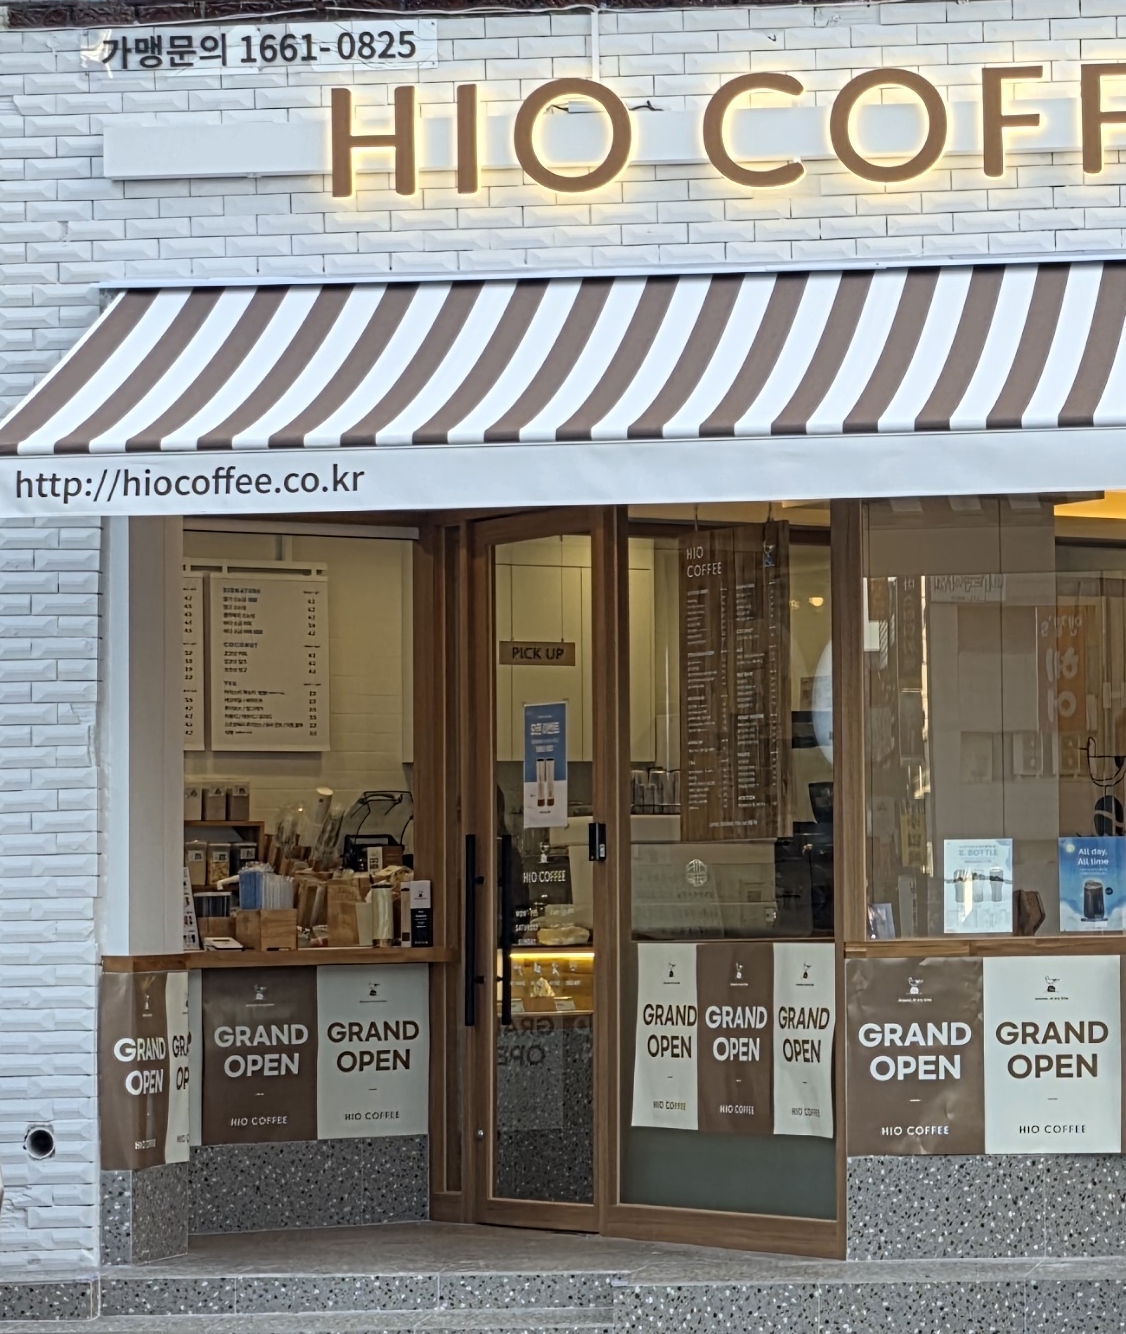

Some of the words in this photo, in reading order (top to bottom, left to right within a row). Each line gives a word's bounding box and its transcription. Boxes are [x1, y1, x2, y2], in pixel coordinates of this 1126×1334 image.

[101, 33, 228, 69] 가맹문의
[240, 29, 417, 65] 1661-0825
[330, 77, 633, 198] HIO
[15, 464, 364, 503] http://hiocoffee.co.kr
[687, 546, 704, 560] HIO
[687, 562, 722, 578] COFFEE
[512, 647, 541, 660] PICK
[546, 648, 564, 660] UP
[523, 871, 538, 884] HIO
[643, 1003, 697, 1027] GRAND
[705, 1005, 768, 1029] GRAND
[778, 1006, 830, 1030] GRAND
[214, 1024, 309, 1048] GRAND
[327, 1020, 420, 1044] GRAND
[858, 1022, 972, 1047] GRAND
[995, 1021, 1109, 1045] GRAND
[113, 1036, 166, 1063] GRAND
[647, 1034, 692, 1059] OPEN
[712, 1037, 760, 1062] OPEN
[783, 1038, 822, 1063] OPEN
[224, 1053, 300, 1078] OPEN
[336, 1049, 411, 1073] OPEN
[870, 1055, 961, 1081] OPEN
[1007, 1053, 1098, 1079] OPEN
[125, 1069, 163, 1096] OPEN
[231, 1117, 248, 1127] HIO
[252, 1115, 288, 1126] COFFEE
[344, 1112, 362, 1121] HIO
[365, 1110, 400, 1120] COFFEE
[719, 1105, 734, 1114] HIO
[735, 1105, 755, 1115] COFFEE
[881, 1126, 903, 1136] HIO
[906, 1125, 950, 1136] COFFEE
[1019, 1125, 1040, 1134] HIO
[1044, 1125, 1086, 1134] COFFEE
